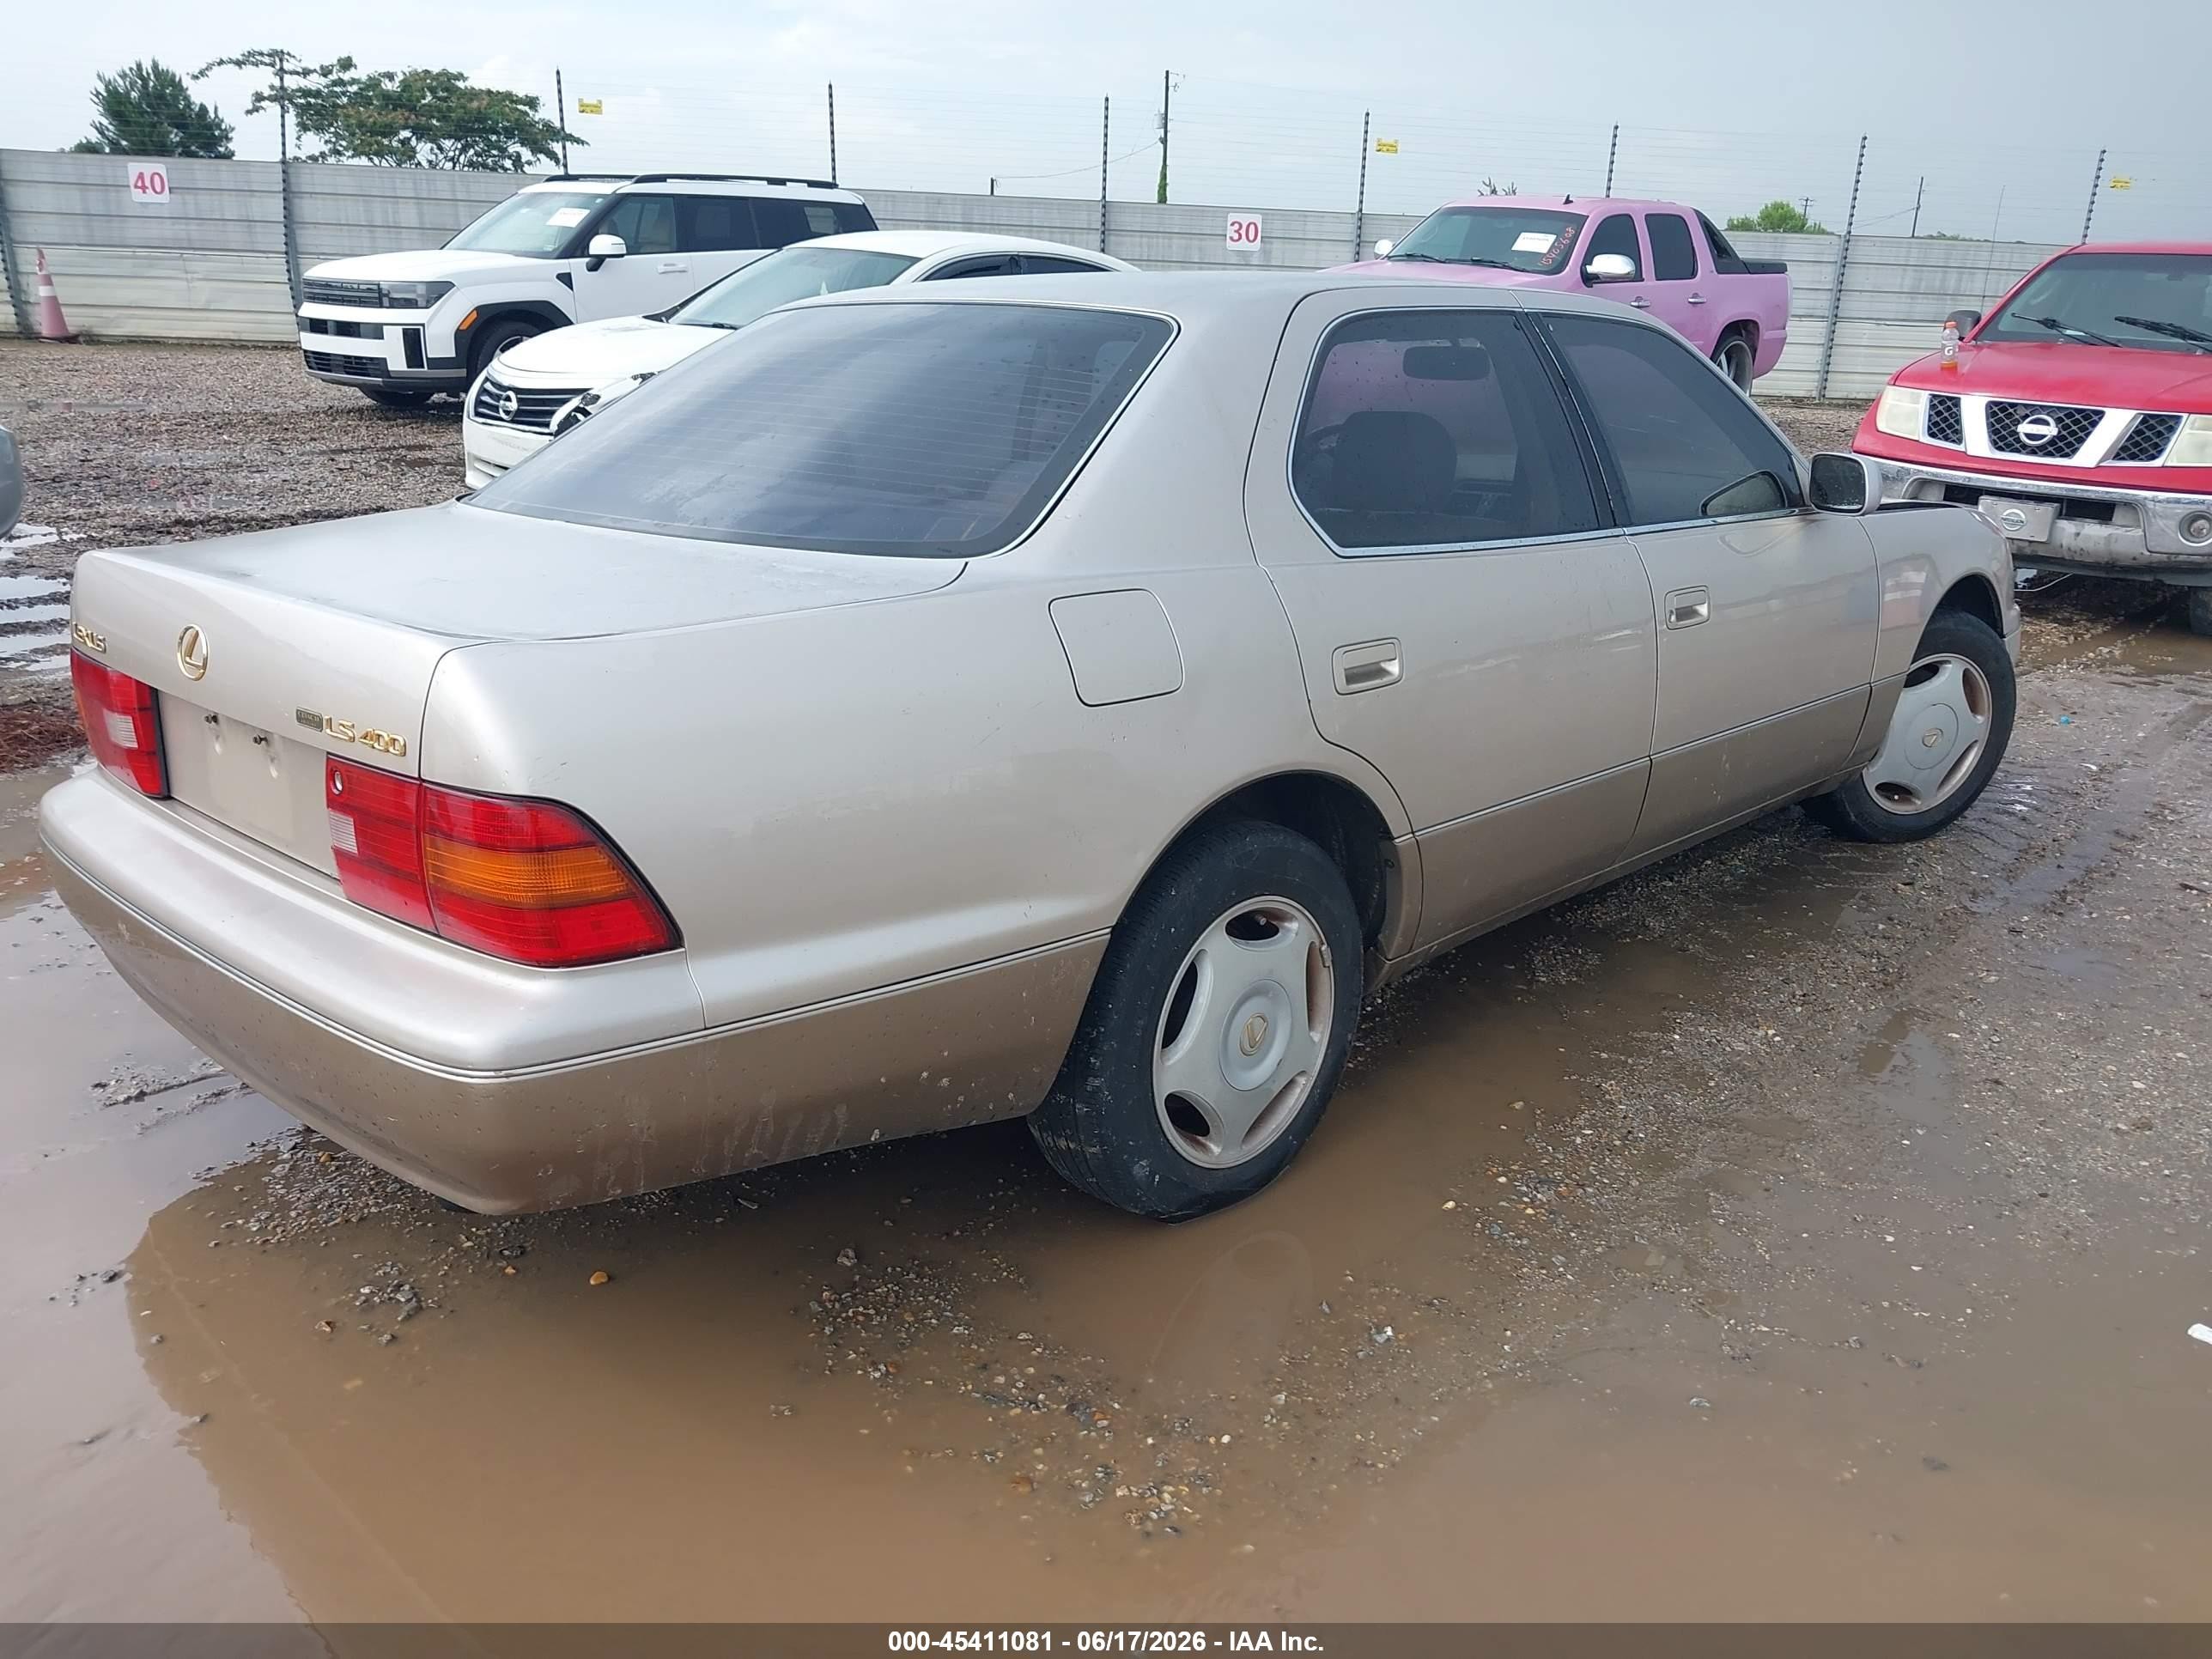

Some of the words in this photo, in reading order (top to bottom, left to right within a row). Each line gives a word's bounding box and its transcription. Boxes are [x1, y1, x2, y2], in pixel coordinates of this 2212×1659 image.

[133, 171, 166, 195] 40
[1229, 220, 1259, 243] 30
[325, 715, 356, 743] LS
[358, 728, 407, 757] 400
